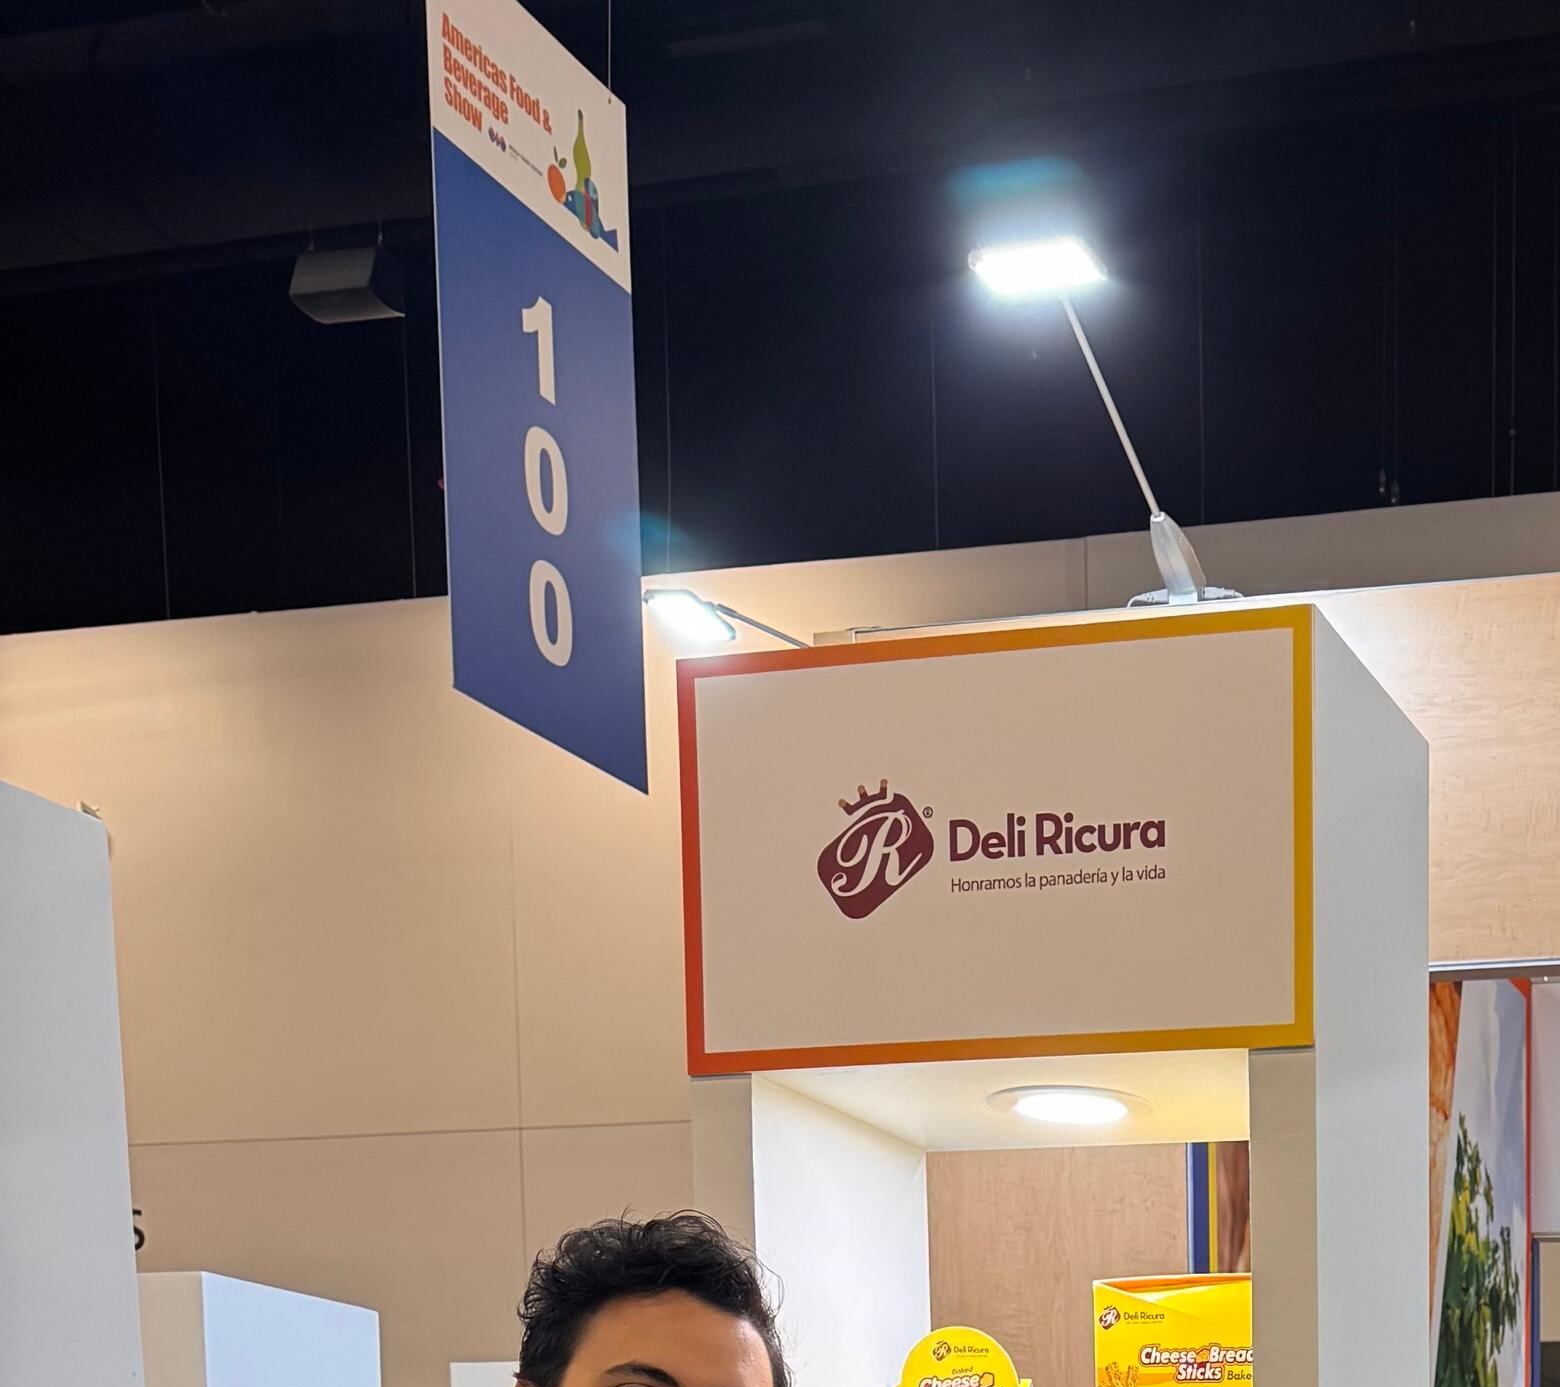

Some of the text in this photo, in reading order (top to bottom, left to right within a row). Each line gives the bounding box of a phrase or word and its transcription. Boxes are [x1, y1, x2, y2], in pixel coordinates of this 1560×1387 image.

[441, 12, 553, 136] Americas Food &
[442, 44, 509, 125] Beverage
[443, 76, 482, 133] Show
[948, 810, 1167, 862] Deli Ricura
[950, 864, 1166, 893] Honramos la panadería y la vida
[1139, 1344, 1196, 1365] Cheese
[1175, 1363, 1223, 1382] Sticks
